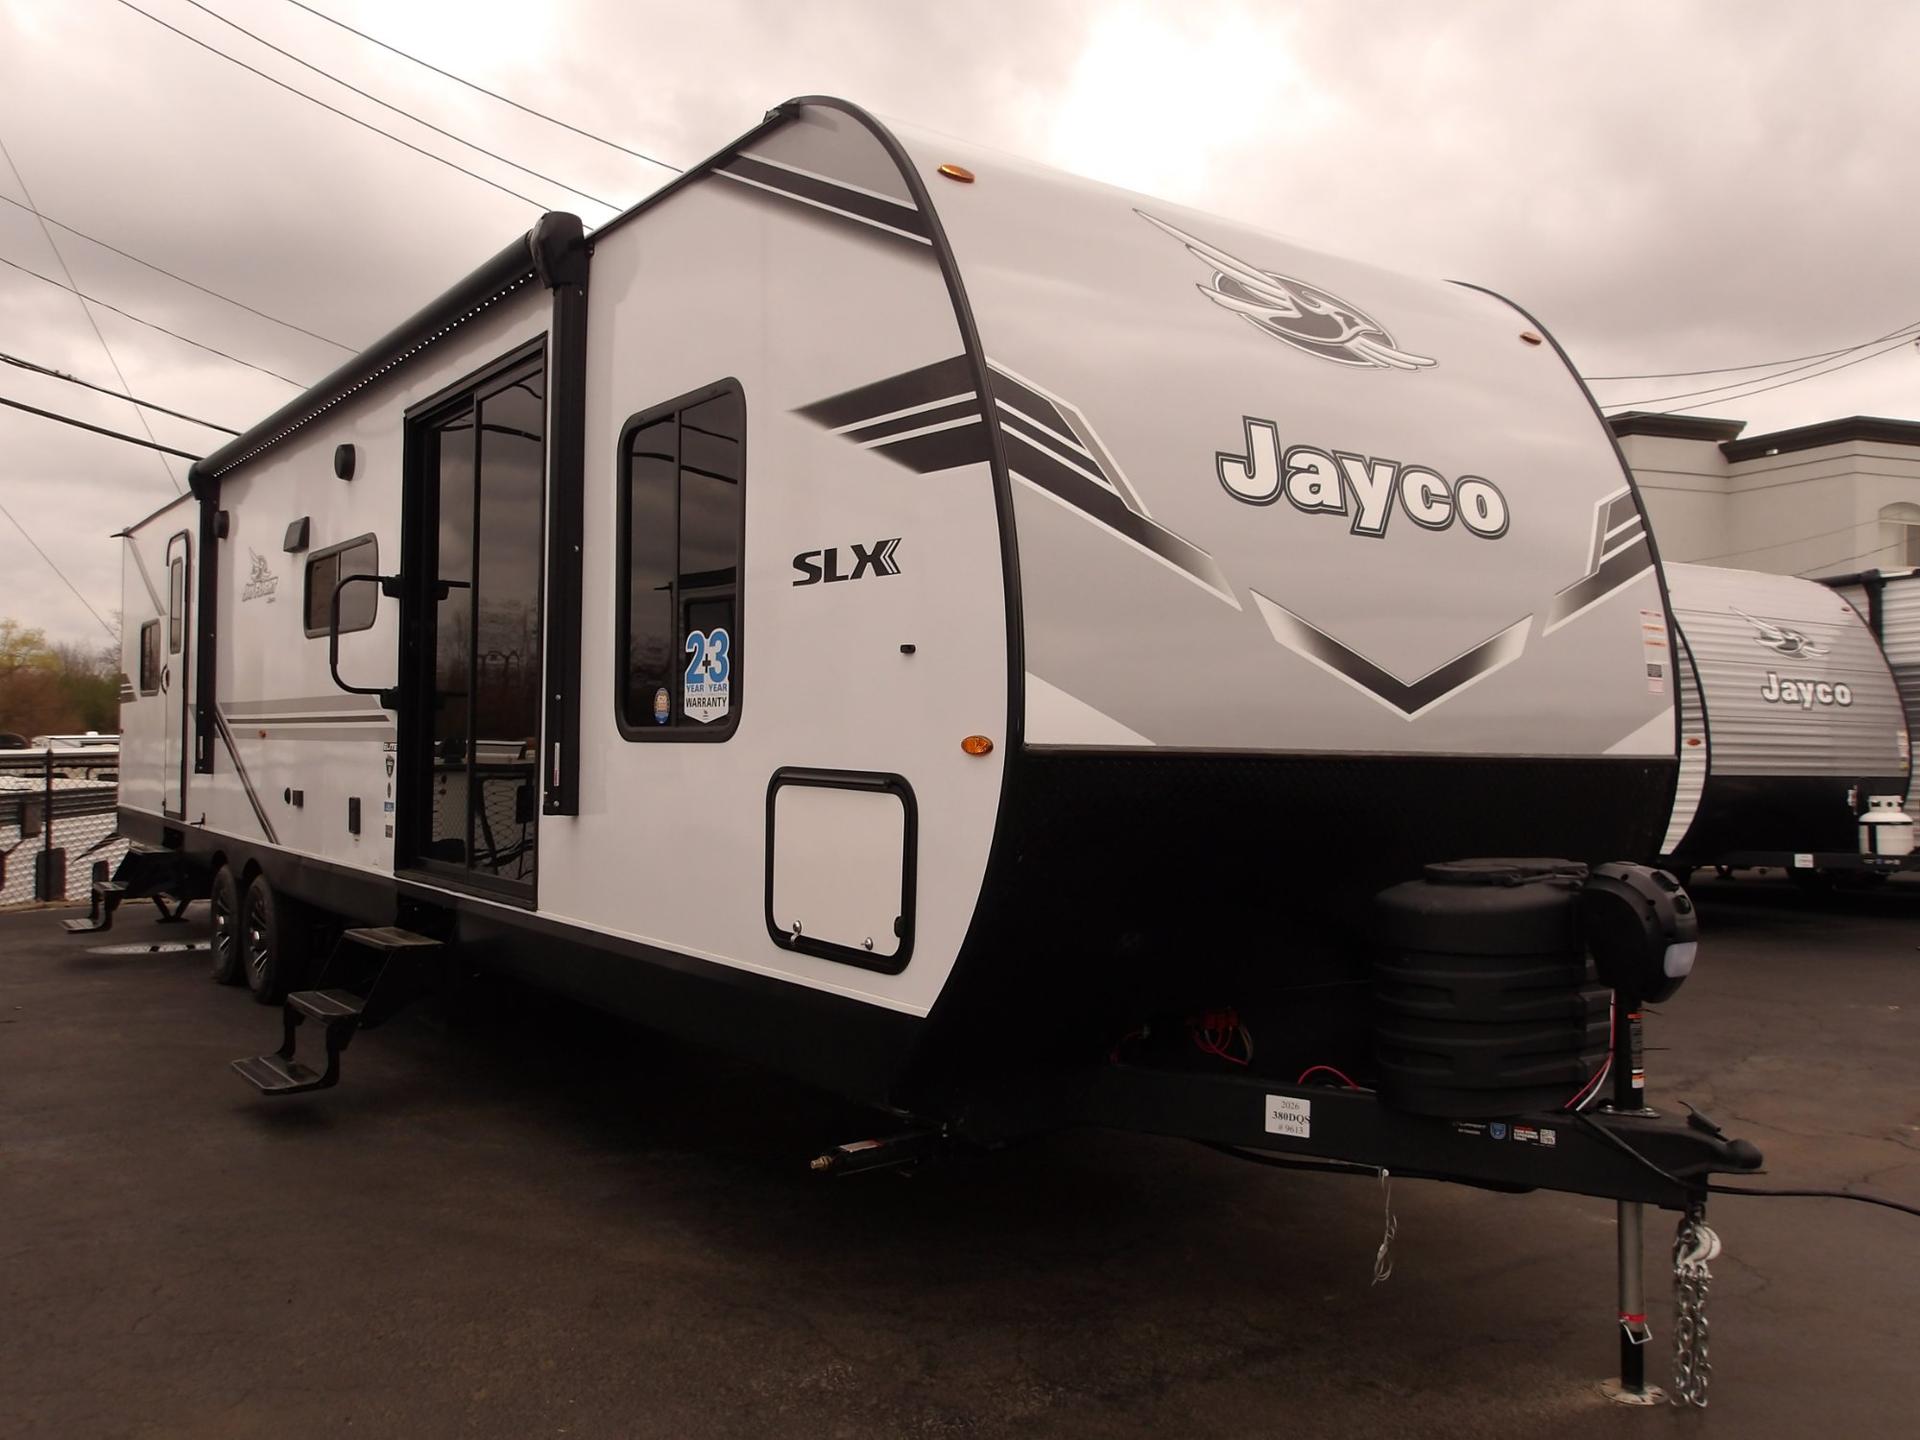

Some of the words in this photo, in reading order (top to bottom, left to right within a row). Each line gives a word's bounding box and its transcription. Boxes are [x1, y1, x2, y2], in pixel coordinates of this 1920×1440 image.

[1215, 415, 1510, 540] Jayco
[793, 538, 902, 587] SLX
[686, 684, 705, 693] YEAR
[709, 683, 728, 693] YEAR
[1761, 671, 1853, 711] Jayco
[686, 696, 727, 708] WARRANTY
[1281, 1101, 1300, 1110] 2026
[1272, 1111, 1311, 1125] 380DQS
